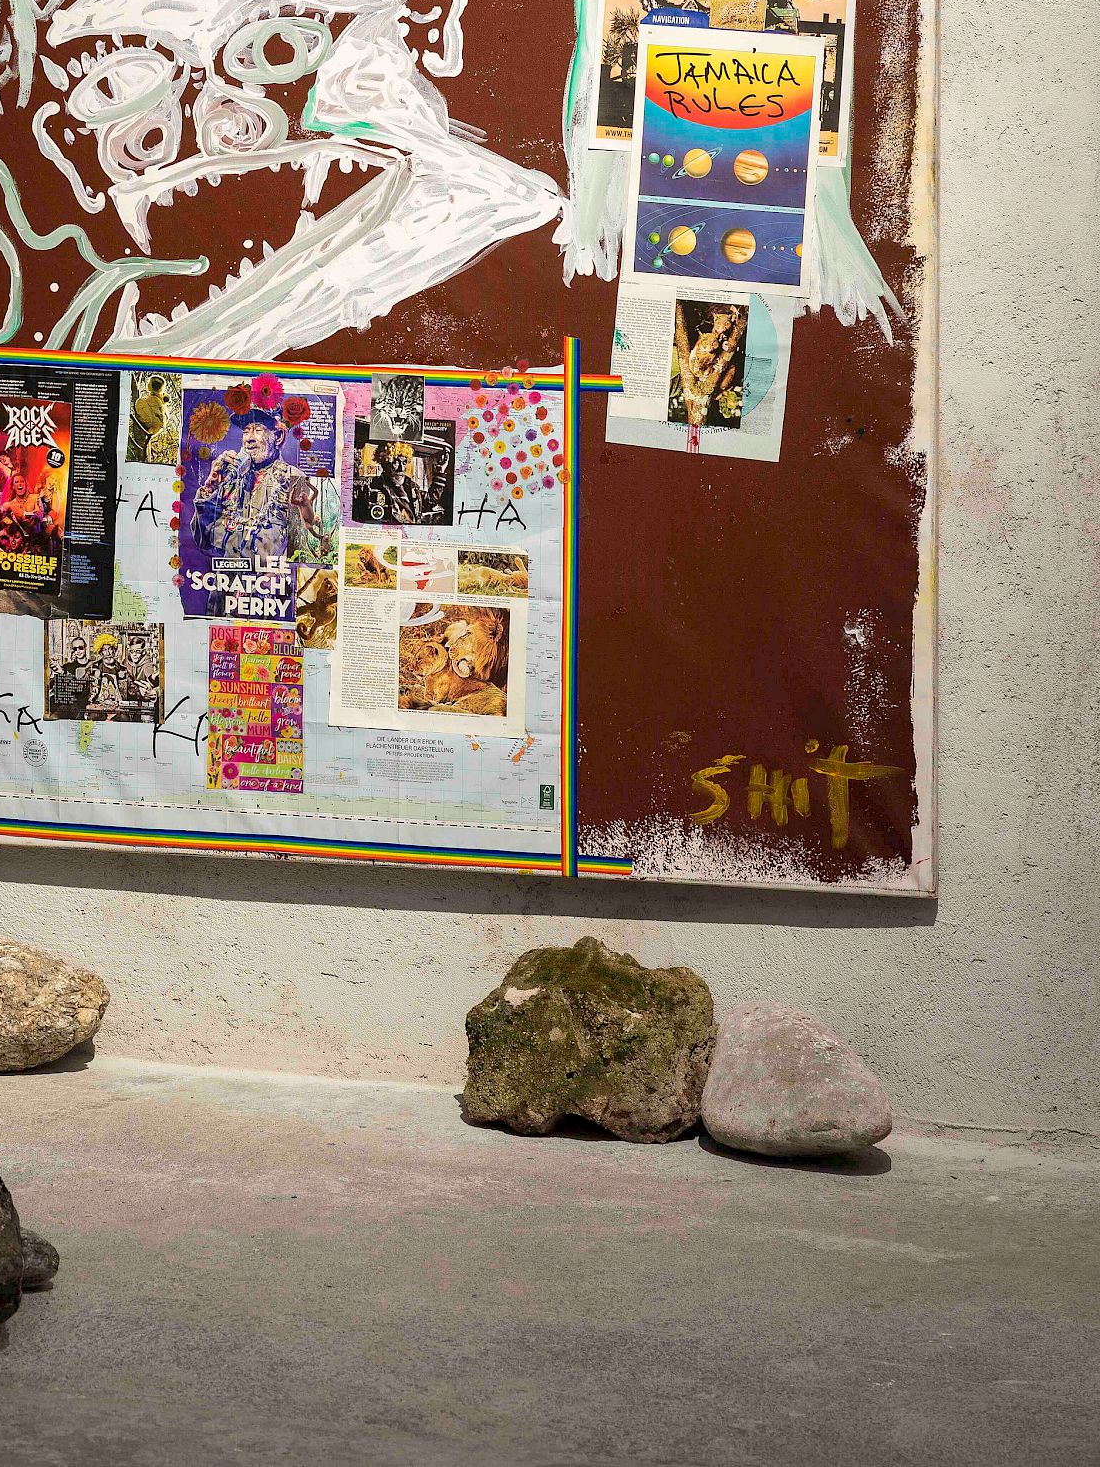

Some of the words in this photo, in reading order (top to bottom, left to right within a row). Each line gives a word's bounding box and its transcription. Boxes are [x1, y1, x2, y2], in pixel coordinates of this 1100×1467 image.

[652, 14, 690, 25] NAVIGATION
[656, 48, 801, 88] JAMAICA
[664, 88, 785, 119] RULES
[2, 402, 59, 432] ROCK
[4, 424, 59, 451] AGES
[458, 493, 527, 531] HA
[13, 562, 57, 577] RESIST.
[215, 561, 249, 569] LEGENDS
[254, 554, 292, 574] LEE
[225, 596, 291, 618] PERRY
[211, 628, 238, 640] ROSE
[242, 629, 272, 643] pretty
[221, 682, 269, 695] SUNSHINE
[274, 692, 301, 704] bloom
[248, 711, 269, 723] hello
[275, 717, 298, 731] grow
[247, 725, 271, 736] MUM
[224, 741, 275, 763] beautiful
[277, 754, 302, 765] DAISY
